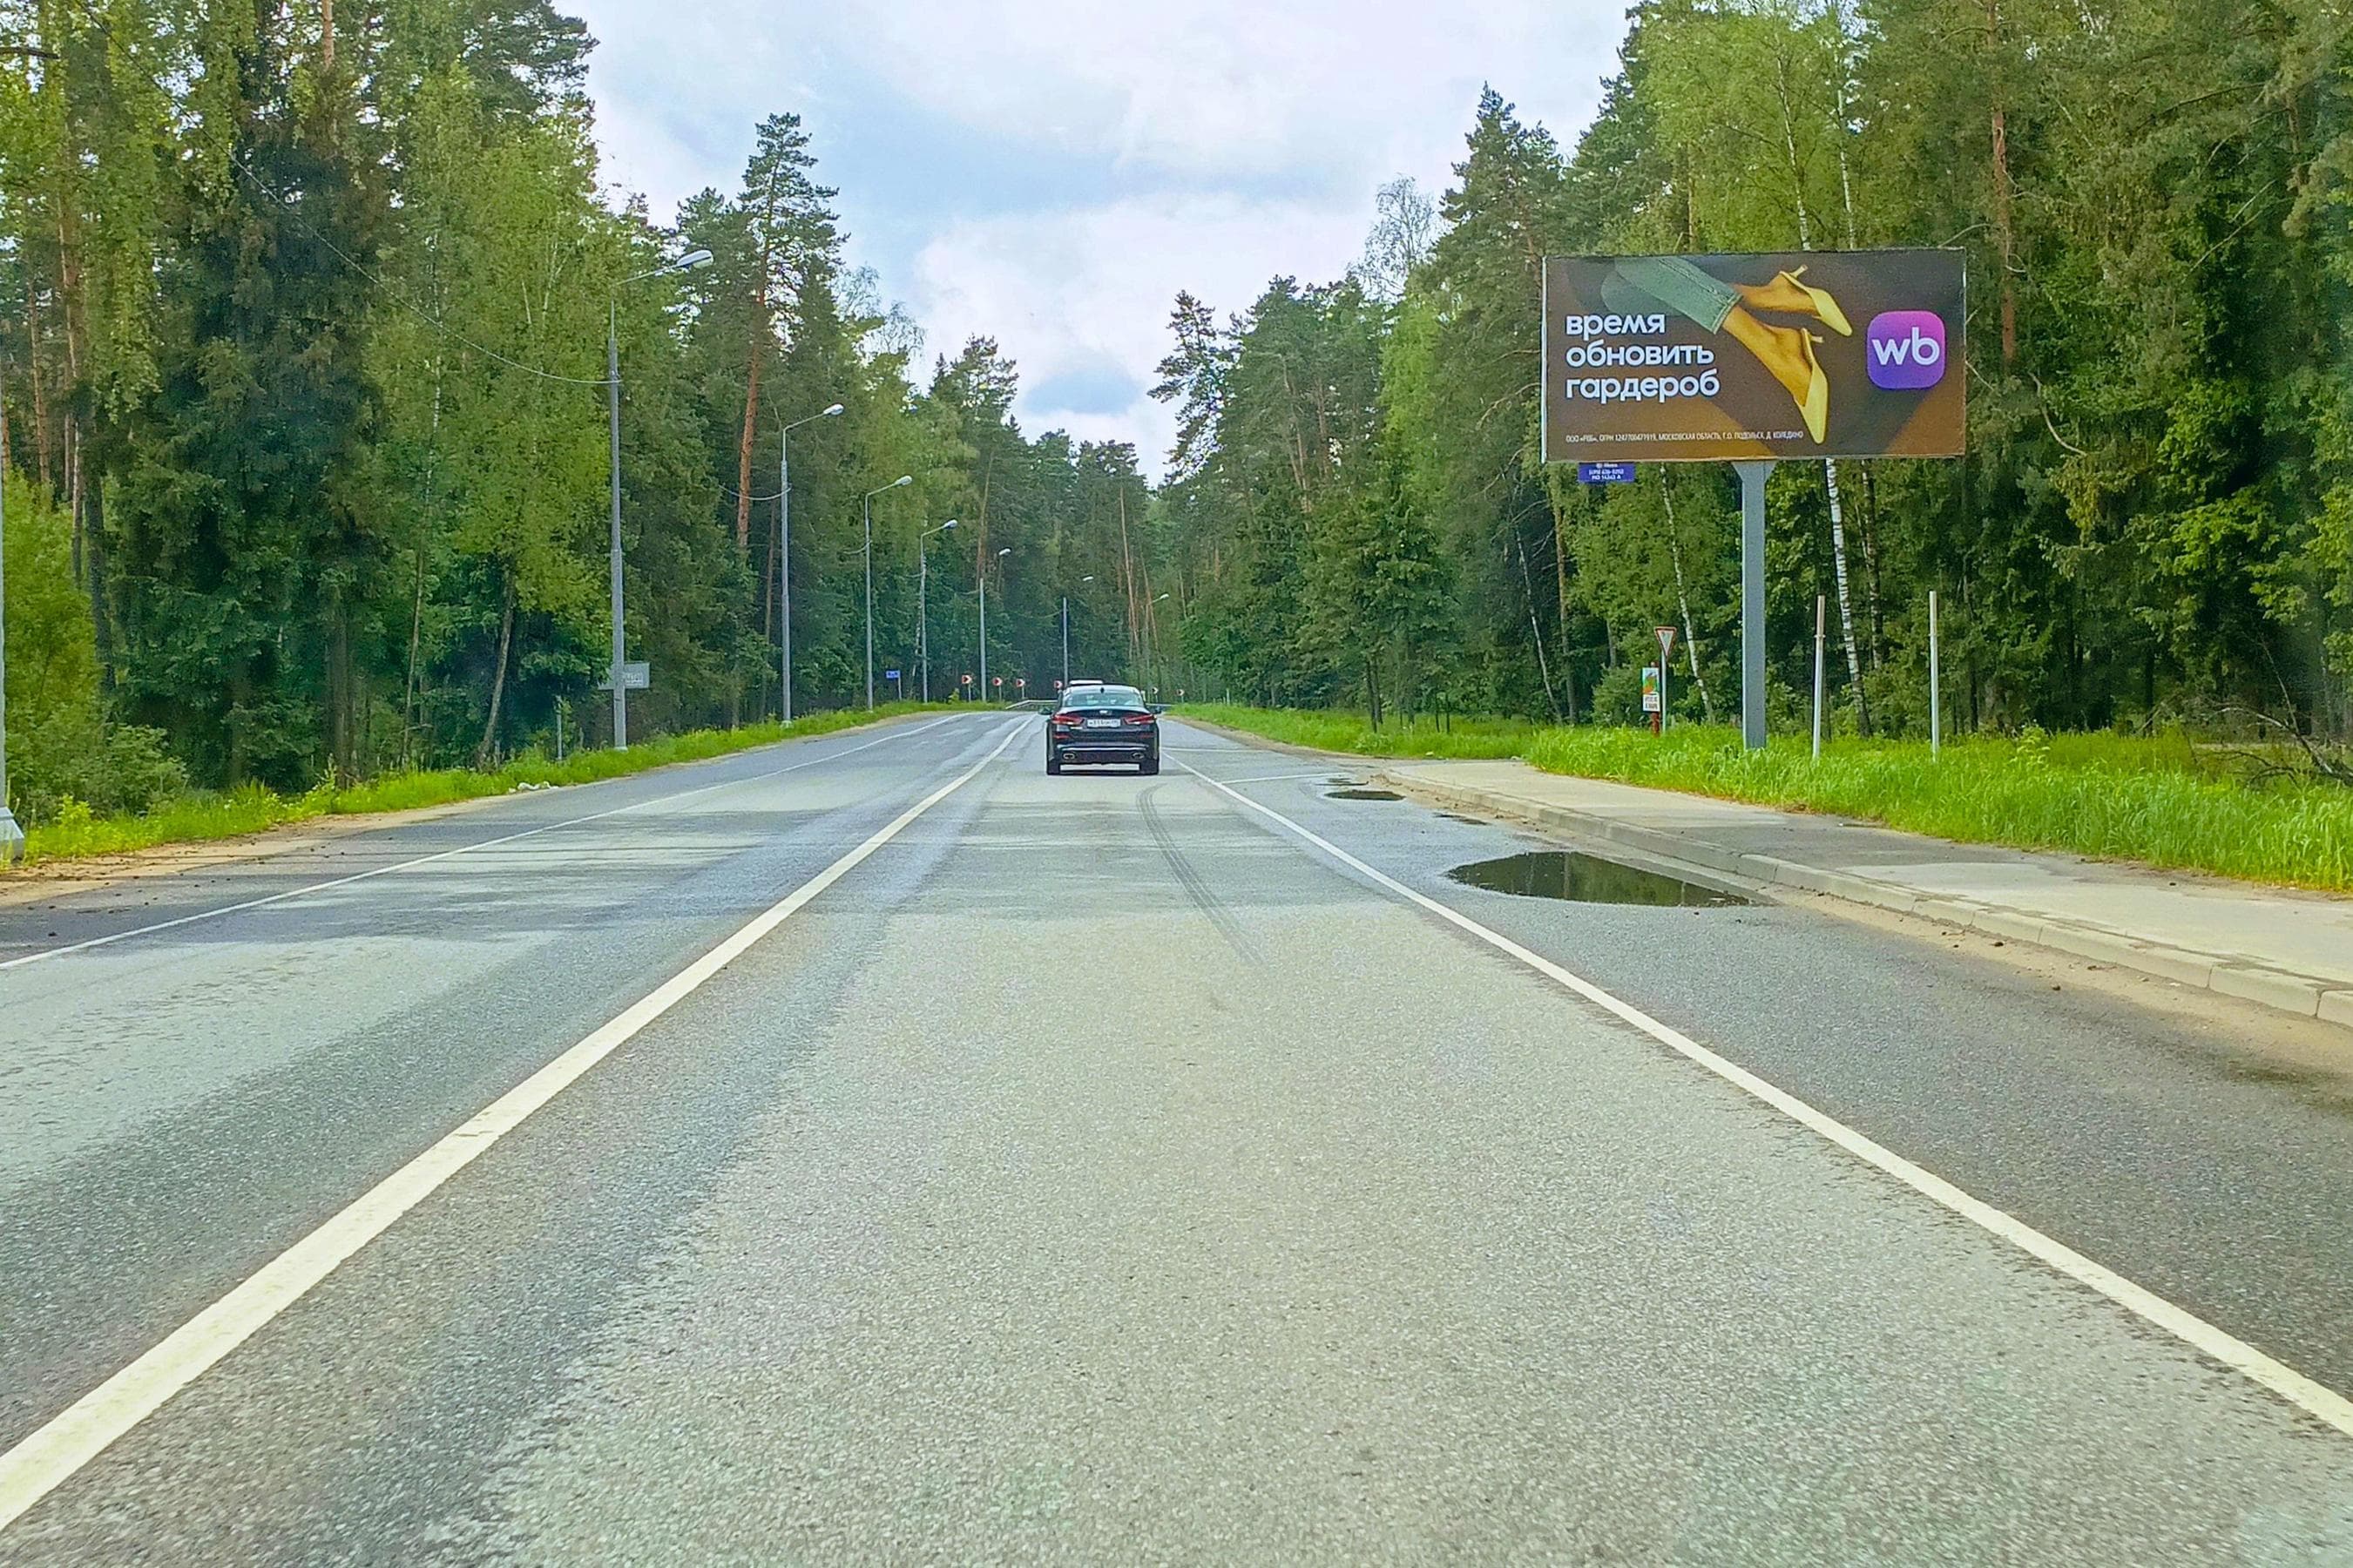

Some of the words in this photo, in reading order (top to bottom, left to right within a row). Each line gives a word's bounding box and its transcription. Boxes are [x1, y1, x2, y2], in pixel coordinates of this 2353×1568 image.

[1565, 314, 1666, 341] время
[1565, 339, 1714, 368] обновить
[1871, 327, 1941, 366] wb
[1565, 368, 1721, 405] гардероб
[1659, 432, 1695, 441] МОСКОВСКАЯ
